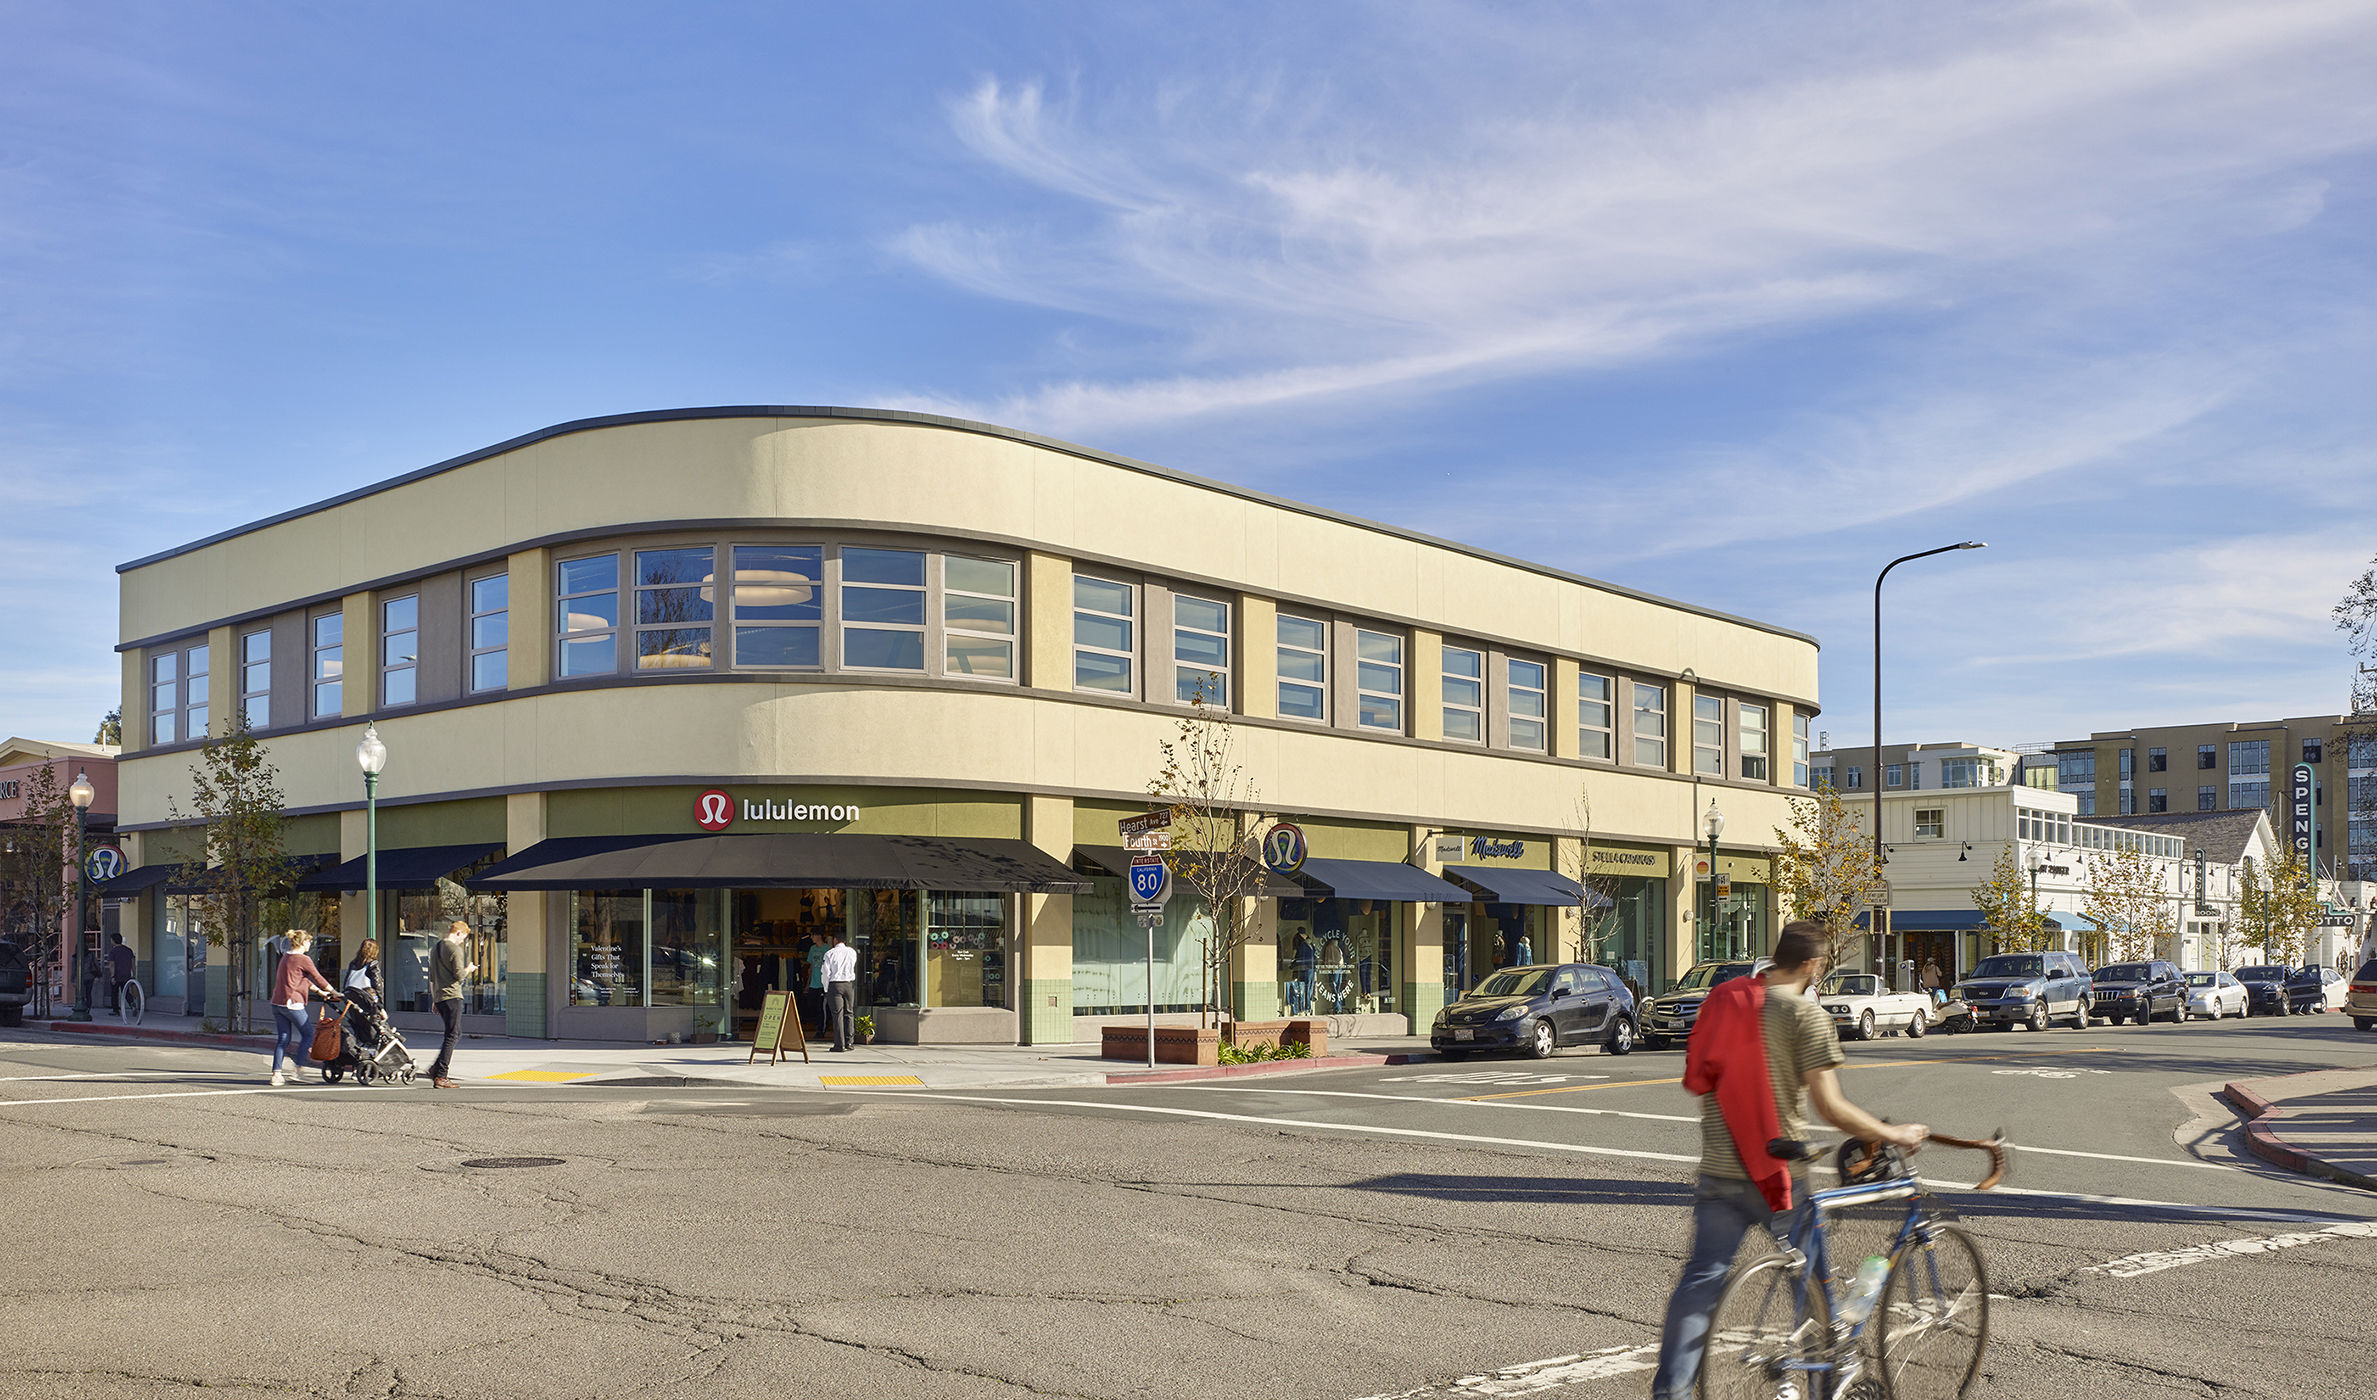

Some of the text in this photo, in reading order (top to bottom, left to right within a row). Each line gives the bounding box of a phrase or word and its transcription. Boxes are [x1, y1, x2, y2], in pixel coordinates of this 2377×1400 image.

[743, 798, 860, 821] lululemon
[1119, 817, 1148, 833] Hearst
[2295, 770, 2309, 897] SPENGE
[1124, 835, 1152, 848] Fourth
[1470, 836, 1525, 861] Madewell
[1137, 873, 1157, 891] 80
[1314, 929, 1356, 959] RECYCLE YOUR
[1315, 979, 1354, 1003] JEANS HERE
